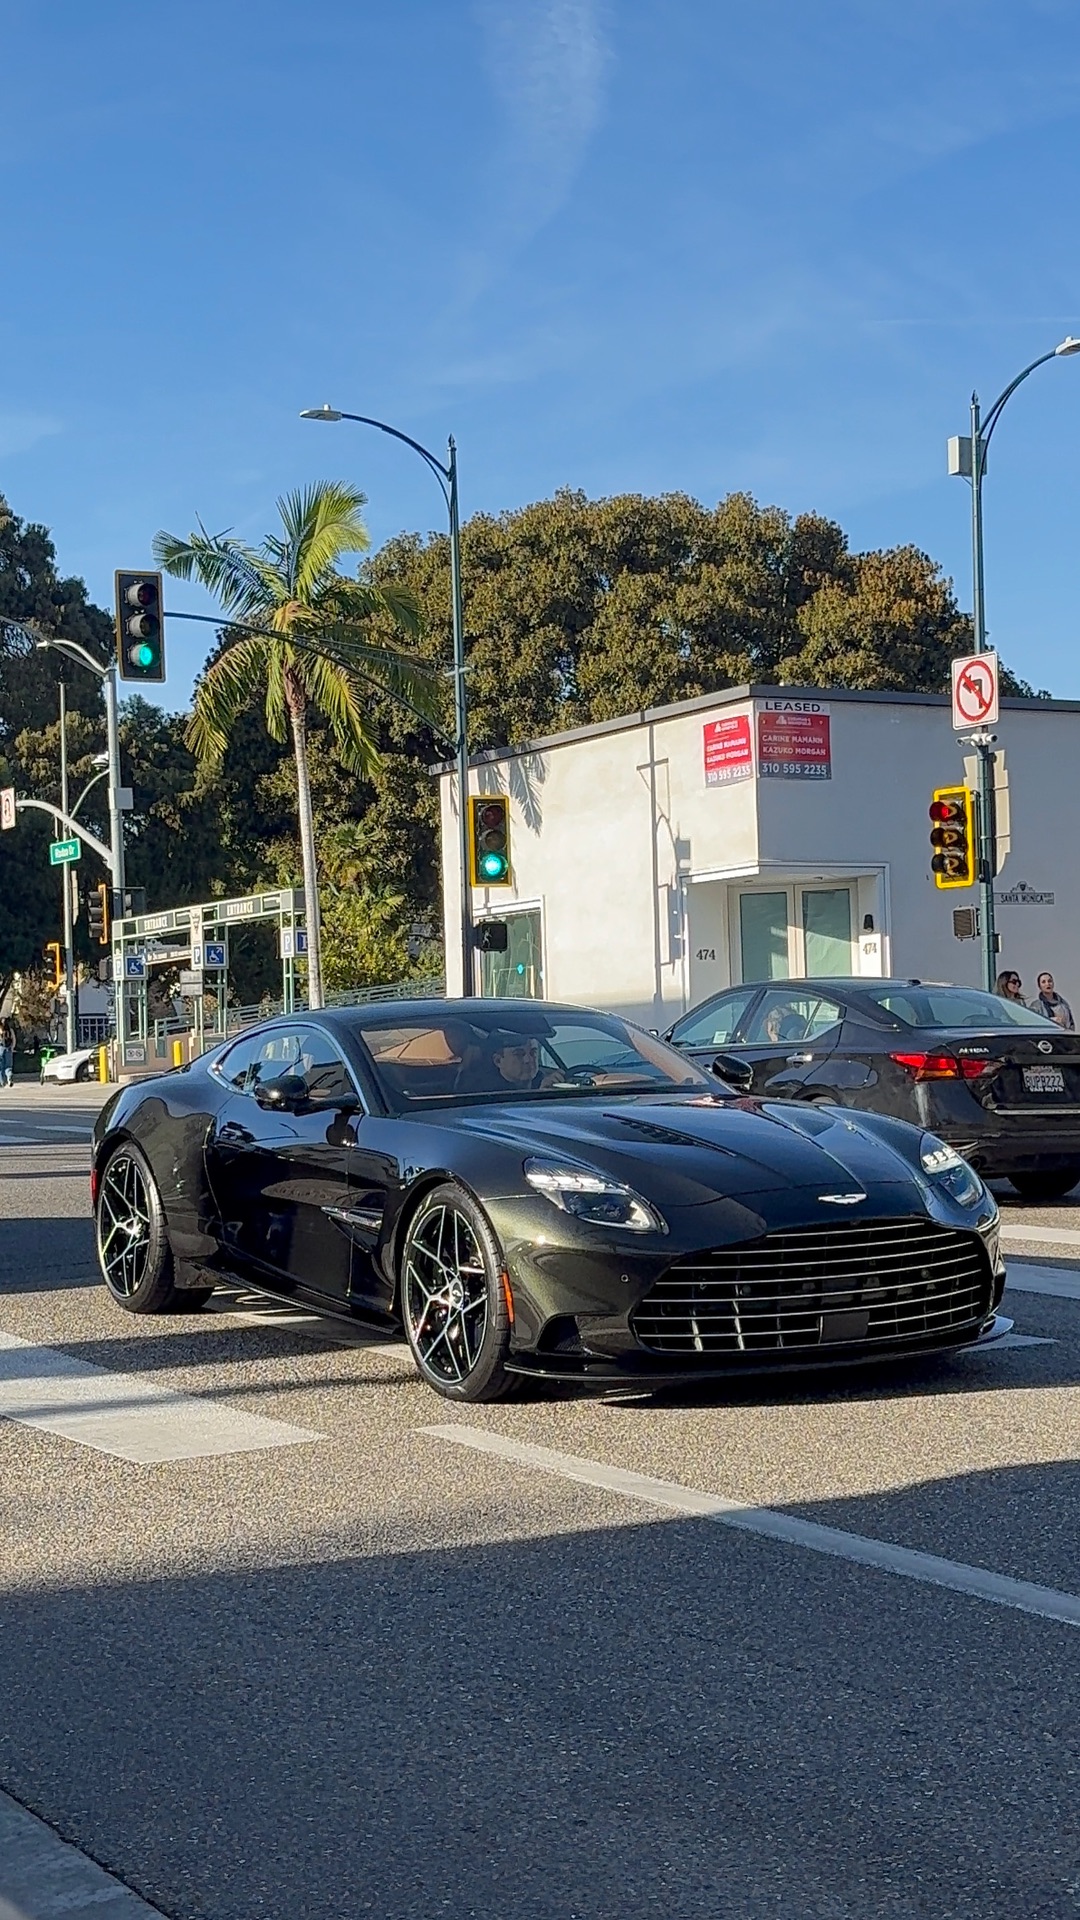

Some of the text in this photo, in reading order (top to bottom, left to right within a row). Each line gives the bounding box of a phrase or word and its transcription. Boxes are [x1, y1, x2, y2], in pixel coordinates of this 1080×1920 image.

[765, 701, 820, 712] LEASED
[762, 734, 790, 743] CARINE
[762, 745, 826, 756] KAZUKO MORGAN
[707, 765, 751, 783] 310 595 2235
[762, 763, 827, 775] 310 595 2235
[1000, 893, 1044, 904] SANTA MONICA
[226, 900, 254, 916] ENTRANCE
[143, 915, 168, 931] ENTRANCE
[863, 942, 877, 955] 474
[194, 948, 200, 963] P
[695, 949, 716, 961] 474
